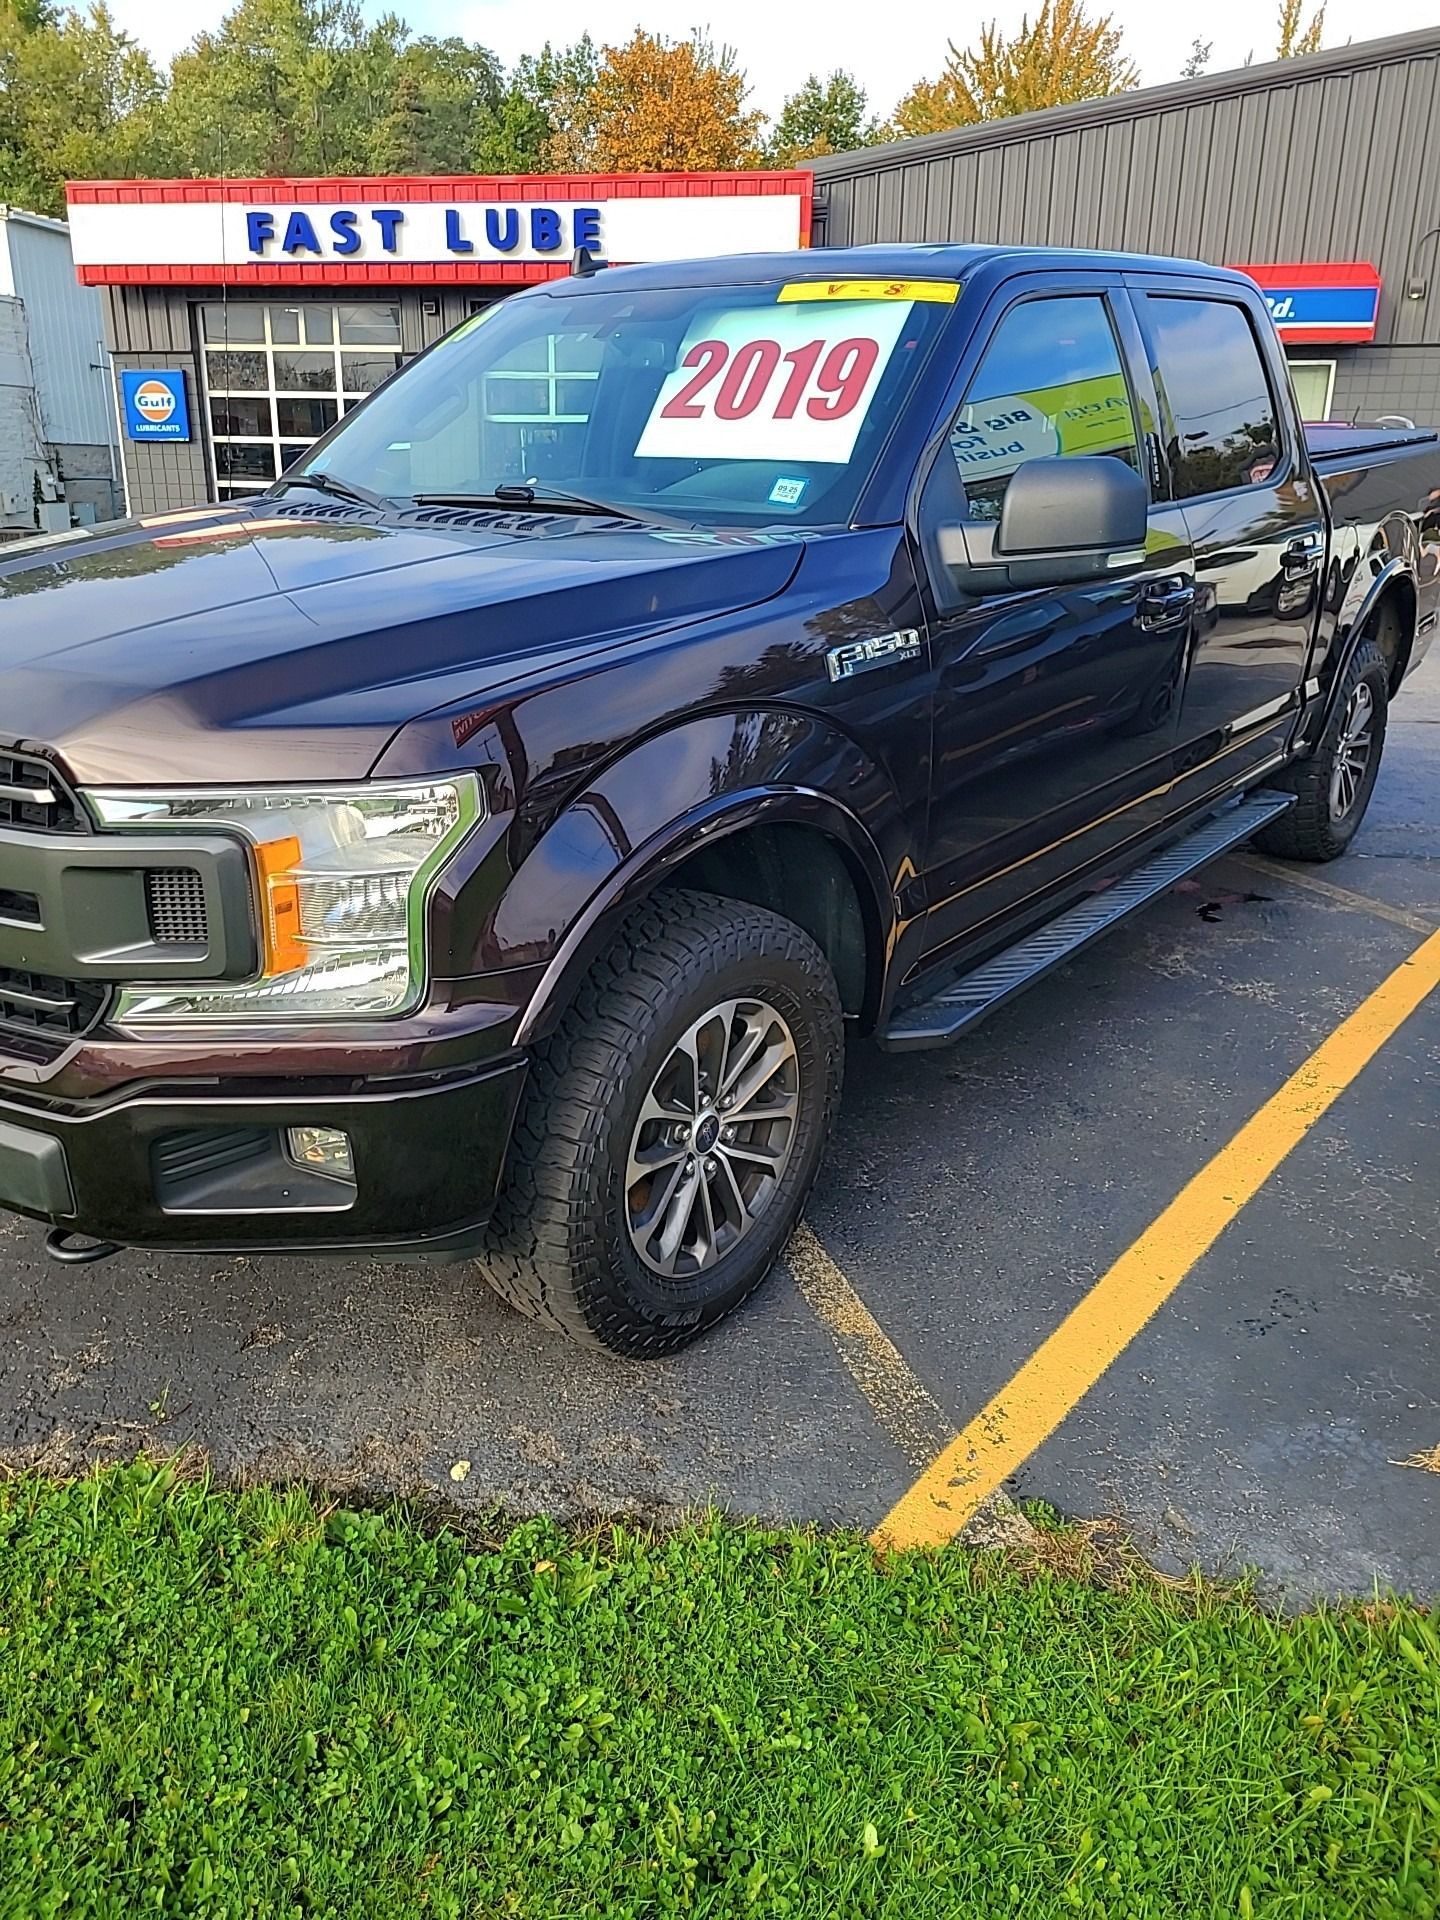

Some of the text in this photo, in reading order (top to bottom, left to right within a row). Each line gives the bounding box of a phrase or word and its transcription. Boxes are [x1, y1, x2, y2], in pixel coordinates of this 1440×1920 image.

[246, 208, 601, 254] FAST LUBE
[828, 284, 848, 296] V
[660, 337, 880, 421] 2019
[138, 395, 172, 408] Gulf
[136, 424, 180, 433] LUBRICANTS
[900, 648, 918, 660] XLT
